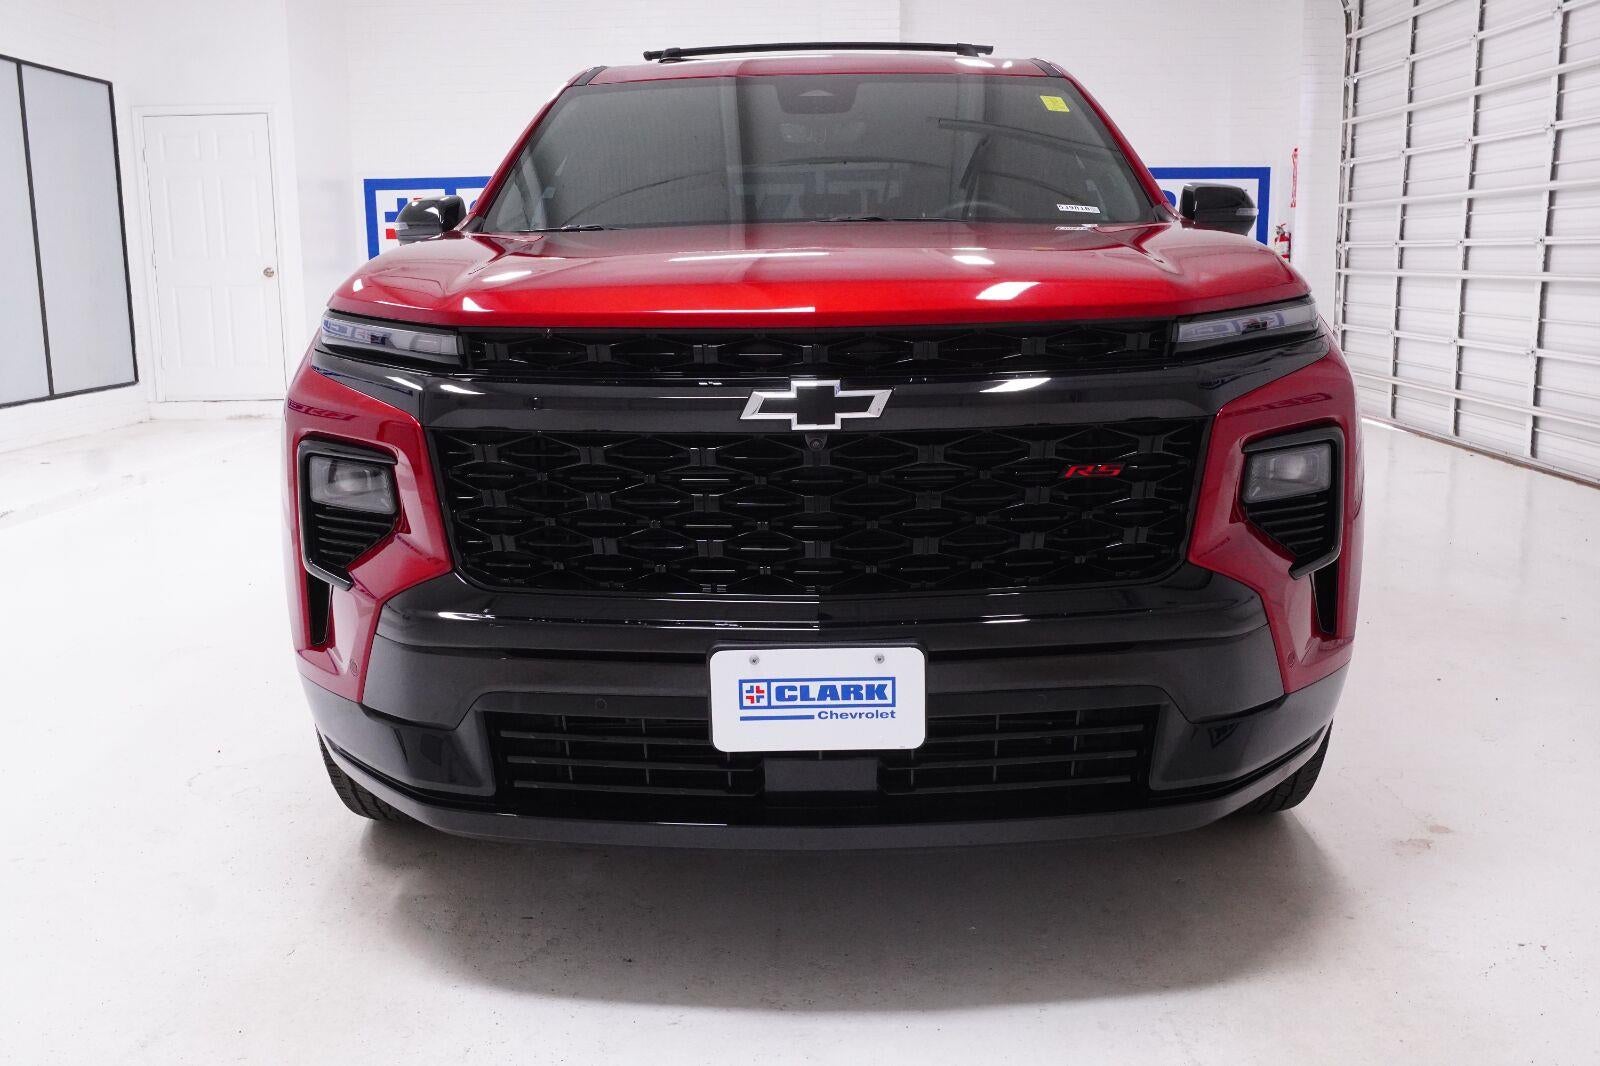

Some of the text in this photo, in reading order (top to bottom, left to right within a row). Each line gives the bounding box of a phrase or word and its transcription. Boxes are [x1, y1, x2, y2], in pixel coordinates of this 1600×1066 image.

[1064, 464, 1123, 479] RS
[775, 683, 888, 702] CLARK
[817, 709, 896, 720] Chevrolet
